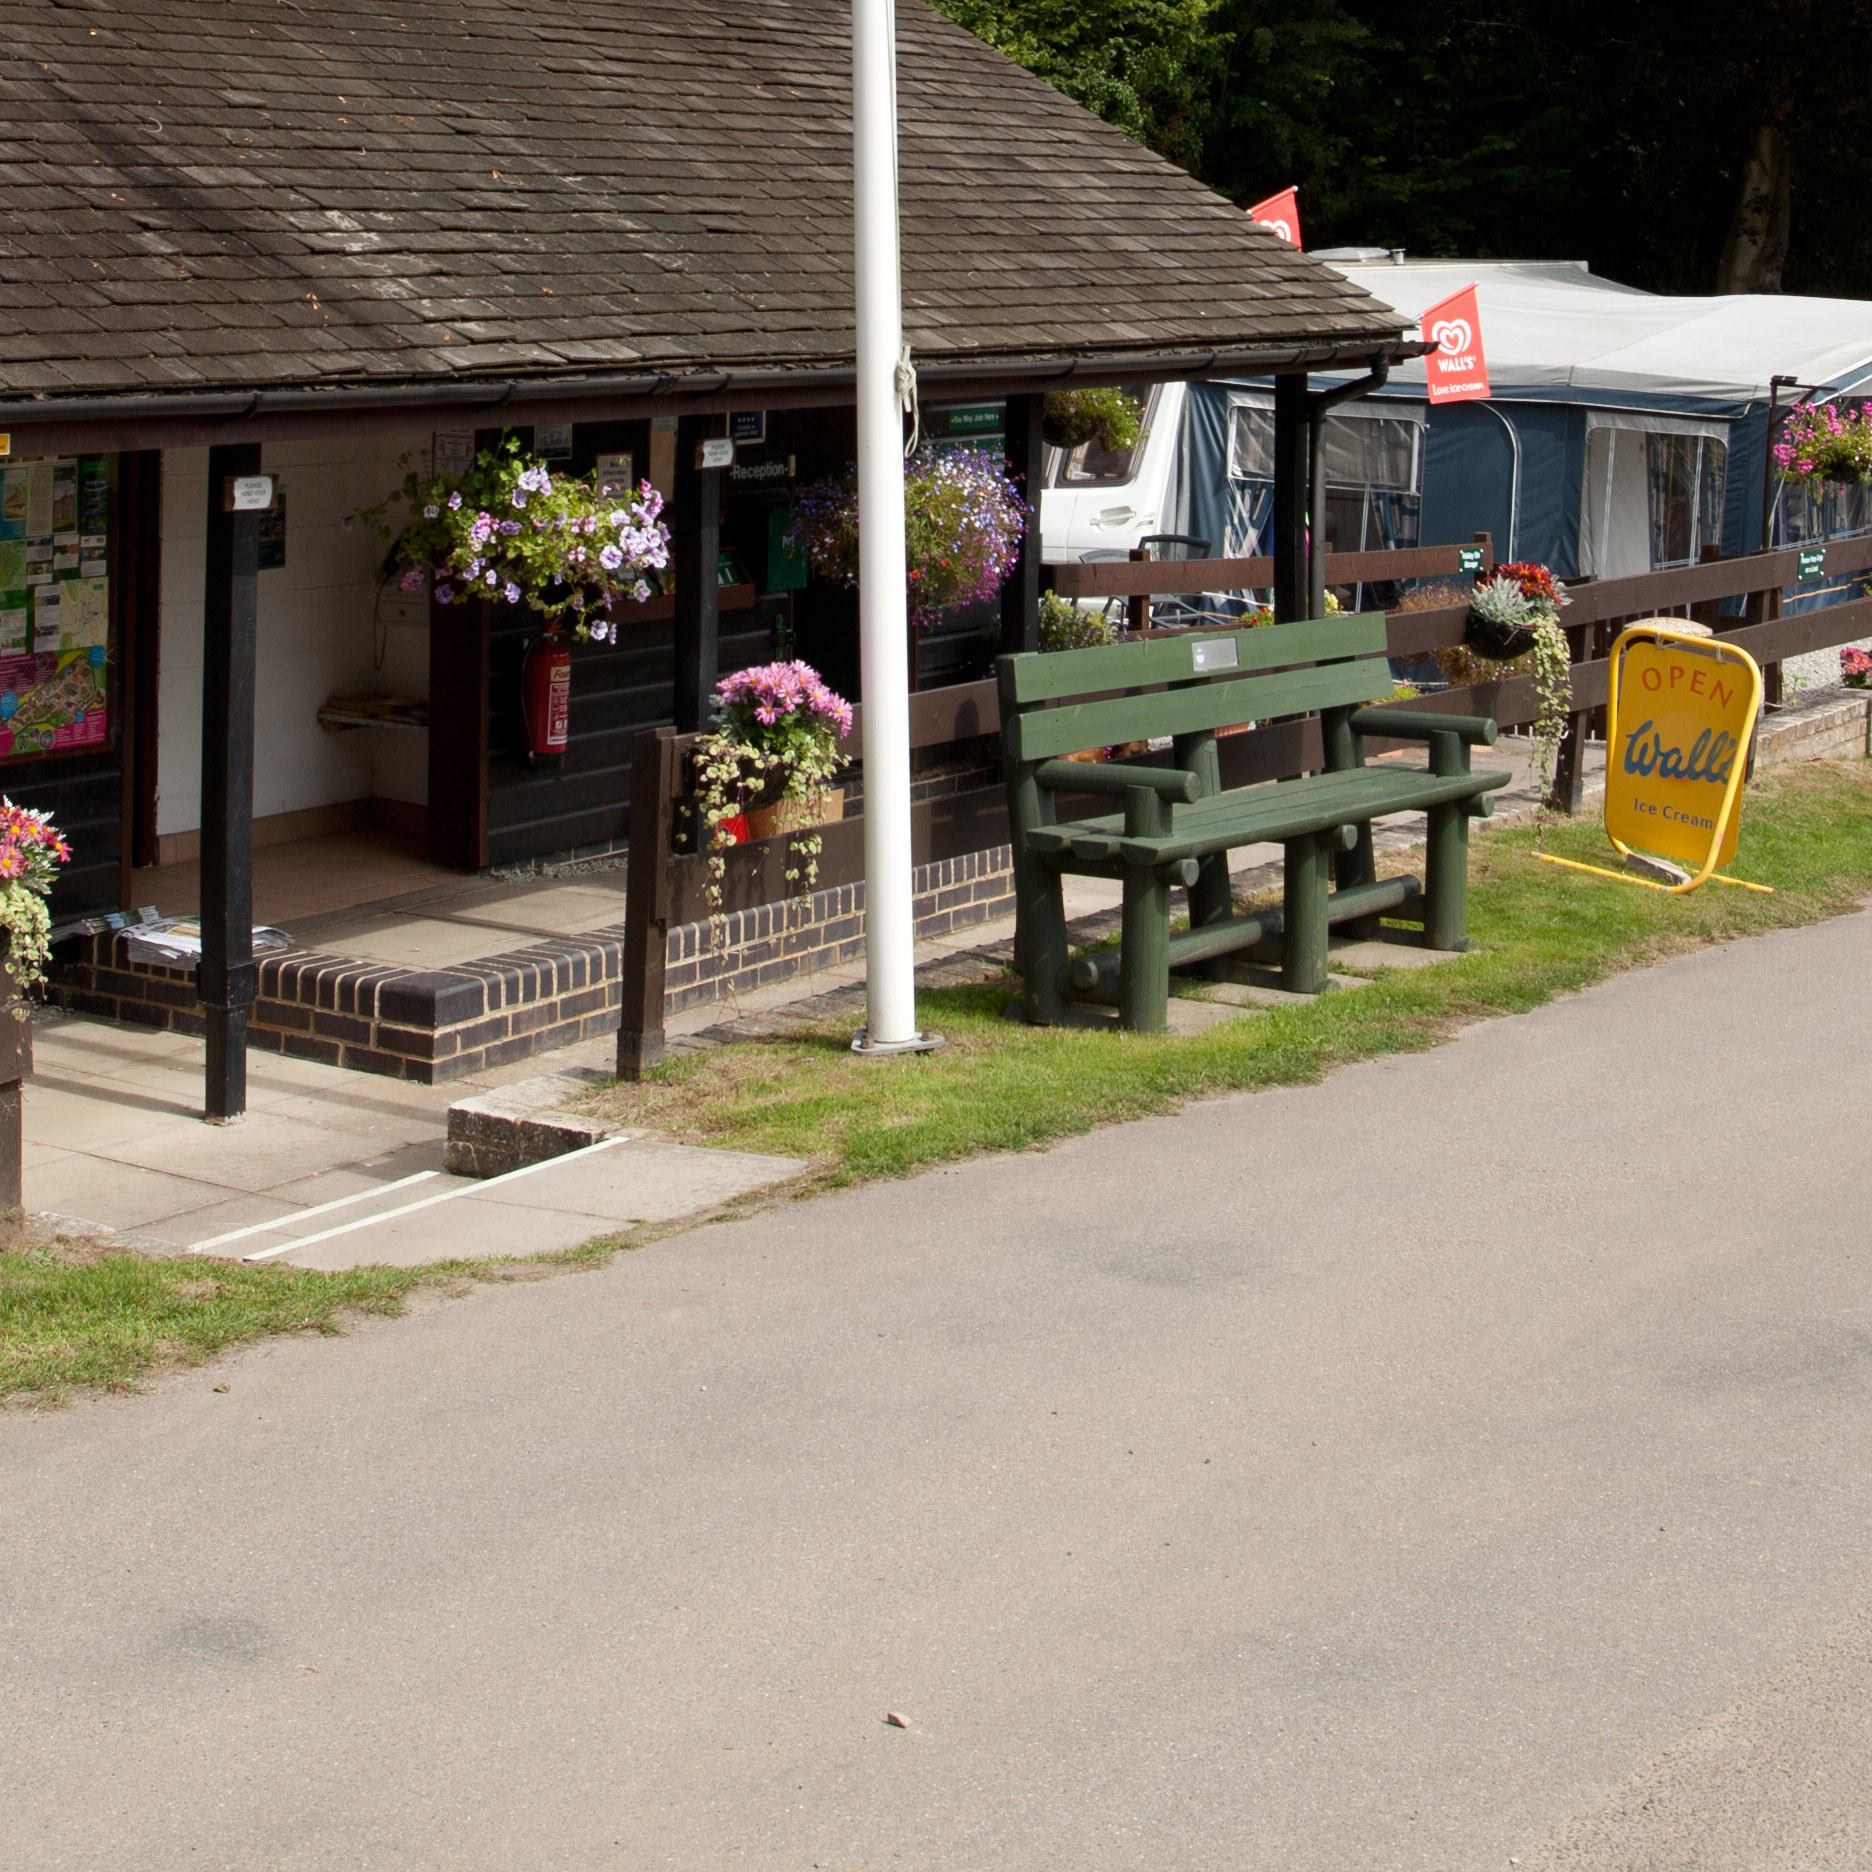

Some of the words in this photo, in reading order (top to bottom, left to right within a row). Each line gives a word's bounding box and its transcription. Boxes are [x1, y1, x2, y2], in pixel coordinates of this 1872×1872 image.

[1437, 356, 1474, 373] WALL'S
[733, 462, 785, 480] Reception
[1642, 666, 1734, 709] OPEN
[1633, 798, 1657, 815] Ice
[1663, 805, 1713, 830] Cream
